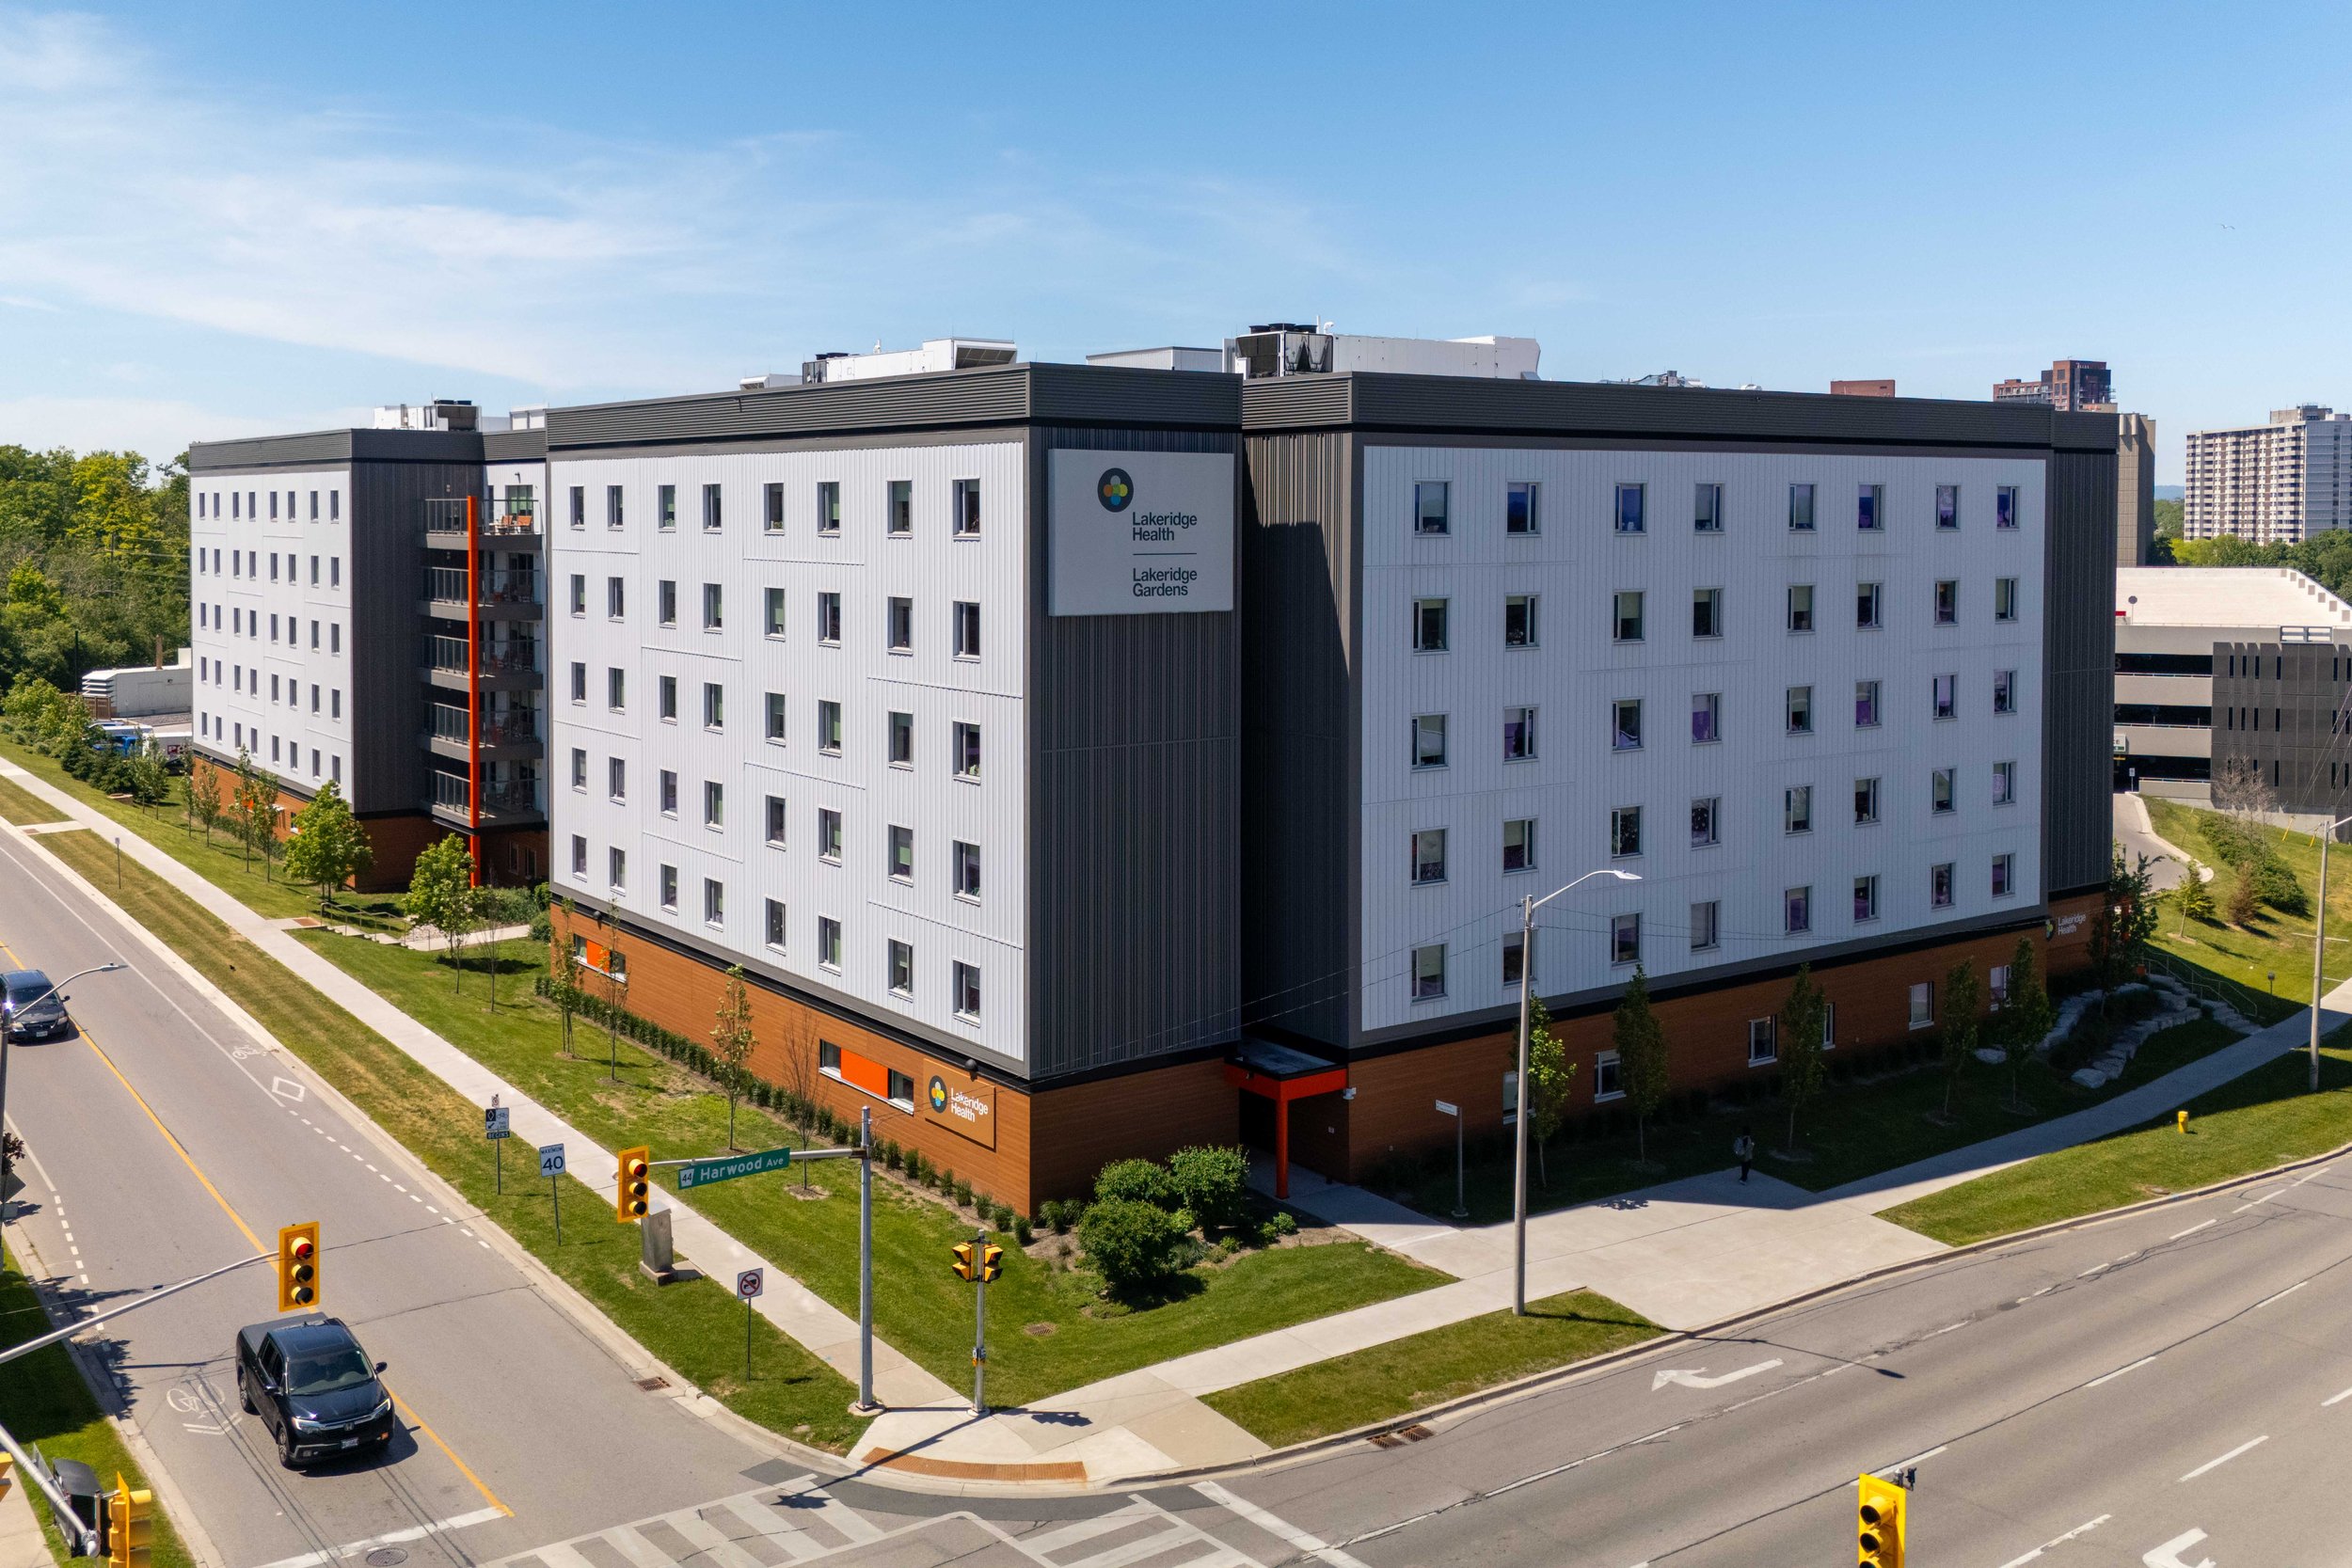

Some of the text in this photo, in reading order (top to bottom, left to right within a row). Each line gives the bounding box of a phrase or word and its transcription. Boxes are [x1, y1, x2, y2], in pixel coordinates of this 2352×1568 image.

[1133, 512, 1198, 529] Lakeridge
[1133, 527, 1174, 541] Health
[1133, 567, 1198, 584] Lakeridge
[1133, 582, 1188, 597] Gardens
[2058, 913, 2086, 927] Lakeridge
[2058, 925, 2077, 936] Health
[950, 1087, 989, 1115] Lakeridge
[950, 1101, 976, 1122] Health
[487, 1131, 509, 1139] BEGINS
[542, 1155, 564, 1171] 40
[682, 1157, 784, 1181] 44 Harwood Ave
